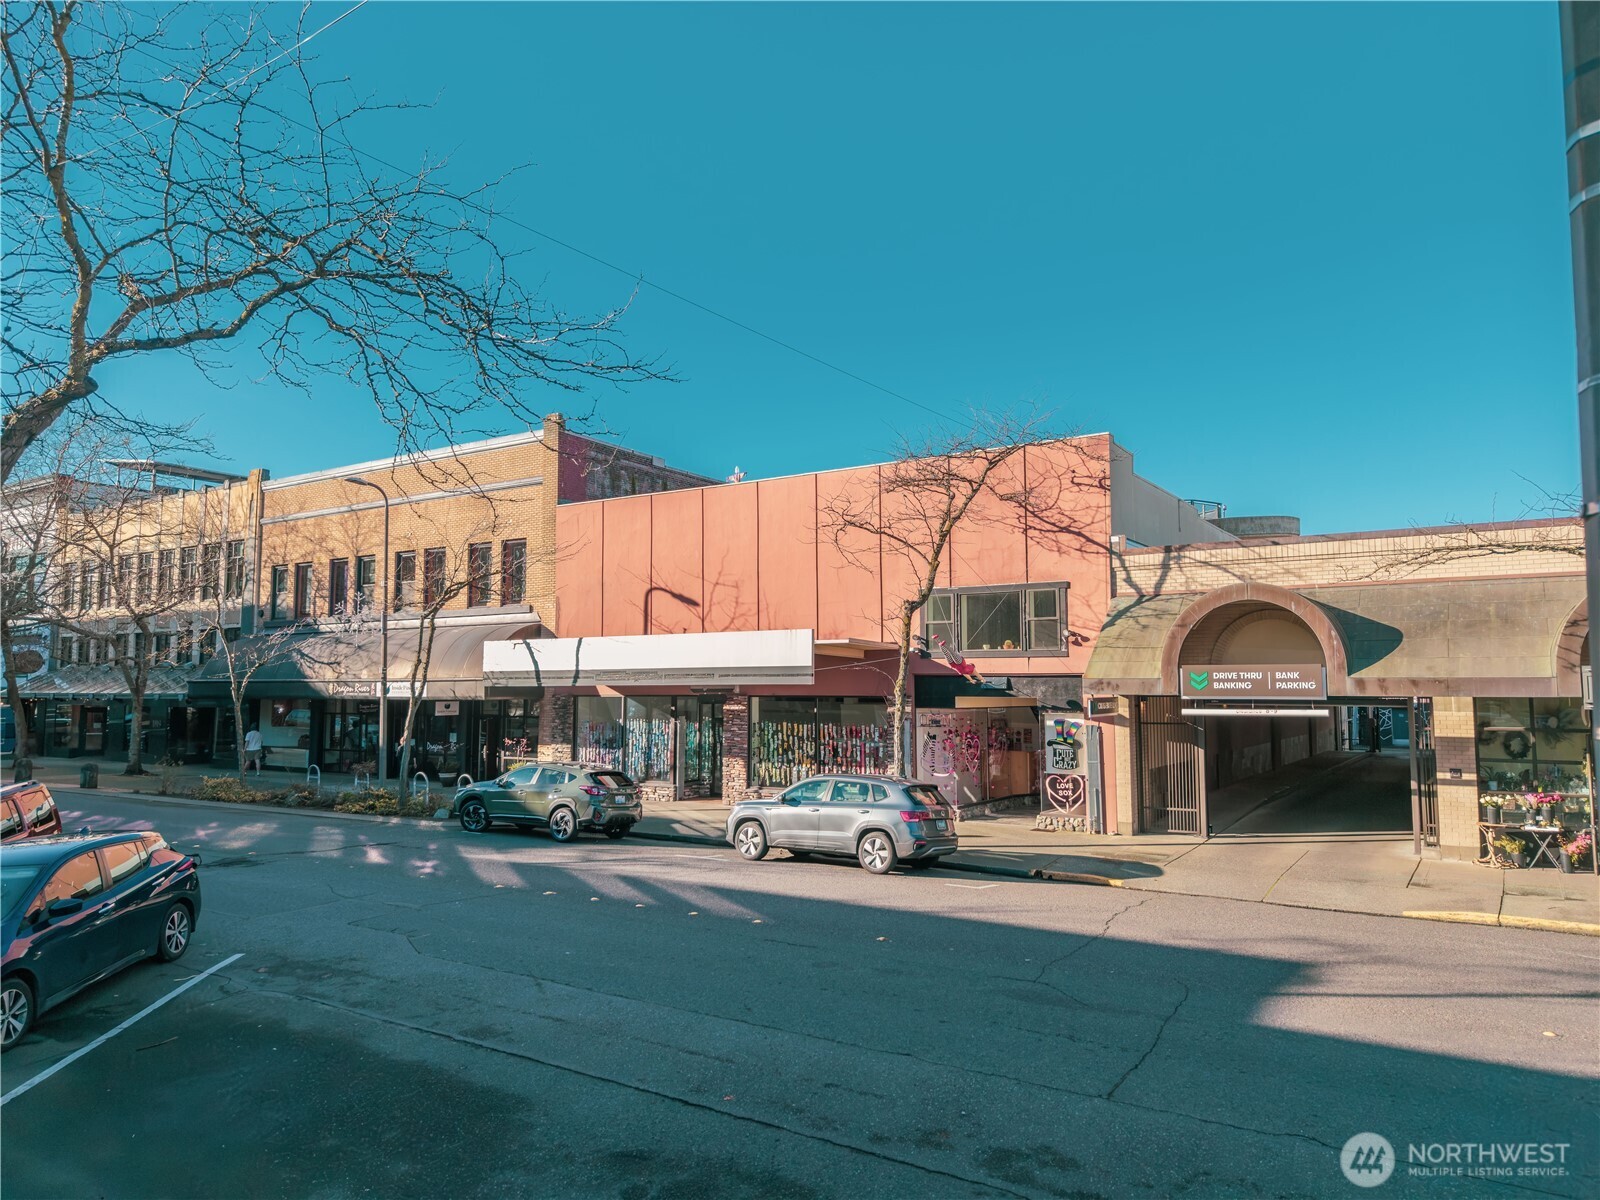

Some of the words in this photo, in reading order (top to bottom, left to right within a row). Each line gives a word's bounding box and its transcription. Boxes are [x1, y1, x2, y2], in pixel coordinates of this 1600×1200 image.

[1275, 671, 1300, 679] BANK
[333, 682, 354, 695] Dragon
[354, 682, 370, 693] River
[1213, 681, 1252, 689] BANKING
[1276, 681, 1316, 689] PARKING
[1056, 750, 1074, 761] CUTE
[1053, 757, 1077, 769] CRAZY
